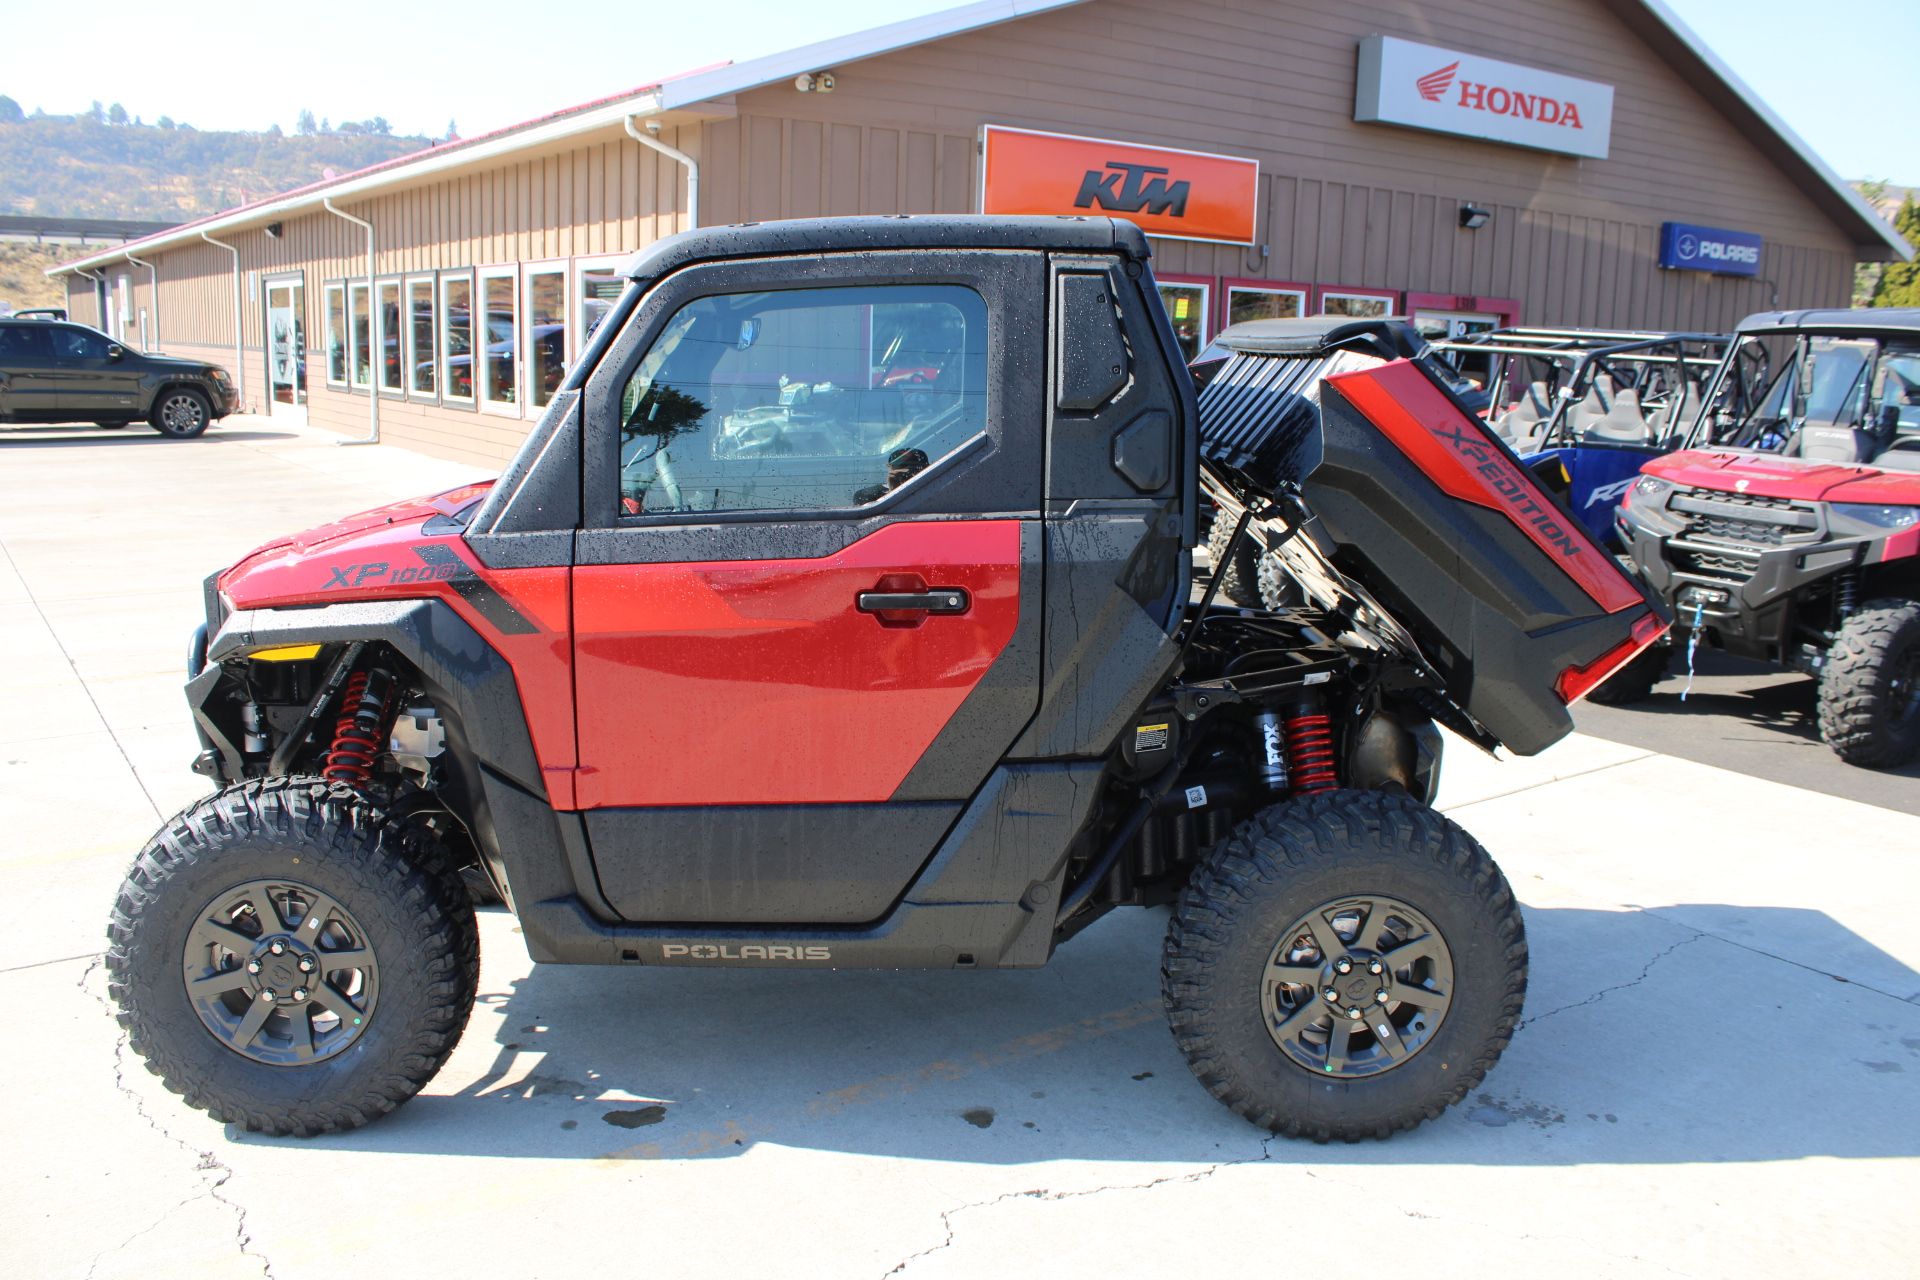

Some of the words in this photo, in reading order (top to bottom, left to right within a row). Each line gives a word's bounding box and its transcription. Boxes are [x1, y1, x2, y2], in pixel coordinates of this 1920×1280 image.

[1458, 80, 1583, 129] HONDA
[1073, 161, 1191, 217] KTM
[1699, 241, 1759, 264] POLARIS
[1430, 426, 1582, 557] XPEDITION
[1583, 475, 1641, 510] RZ
[322, 562, 390, 589] XP
[389, 563, 457, 584] 1000
[1263, 722, 1284, 766] FOX
[662, 944, 832, 960] POLARIS
